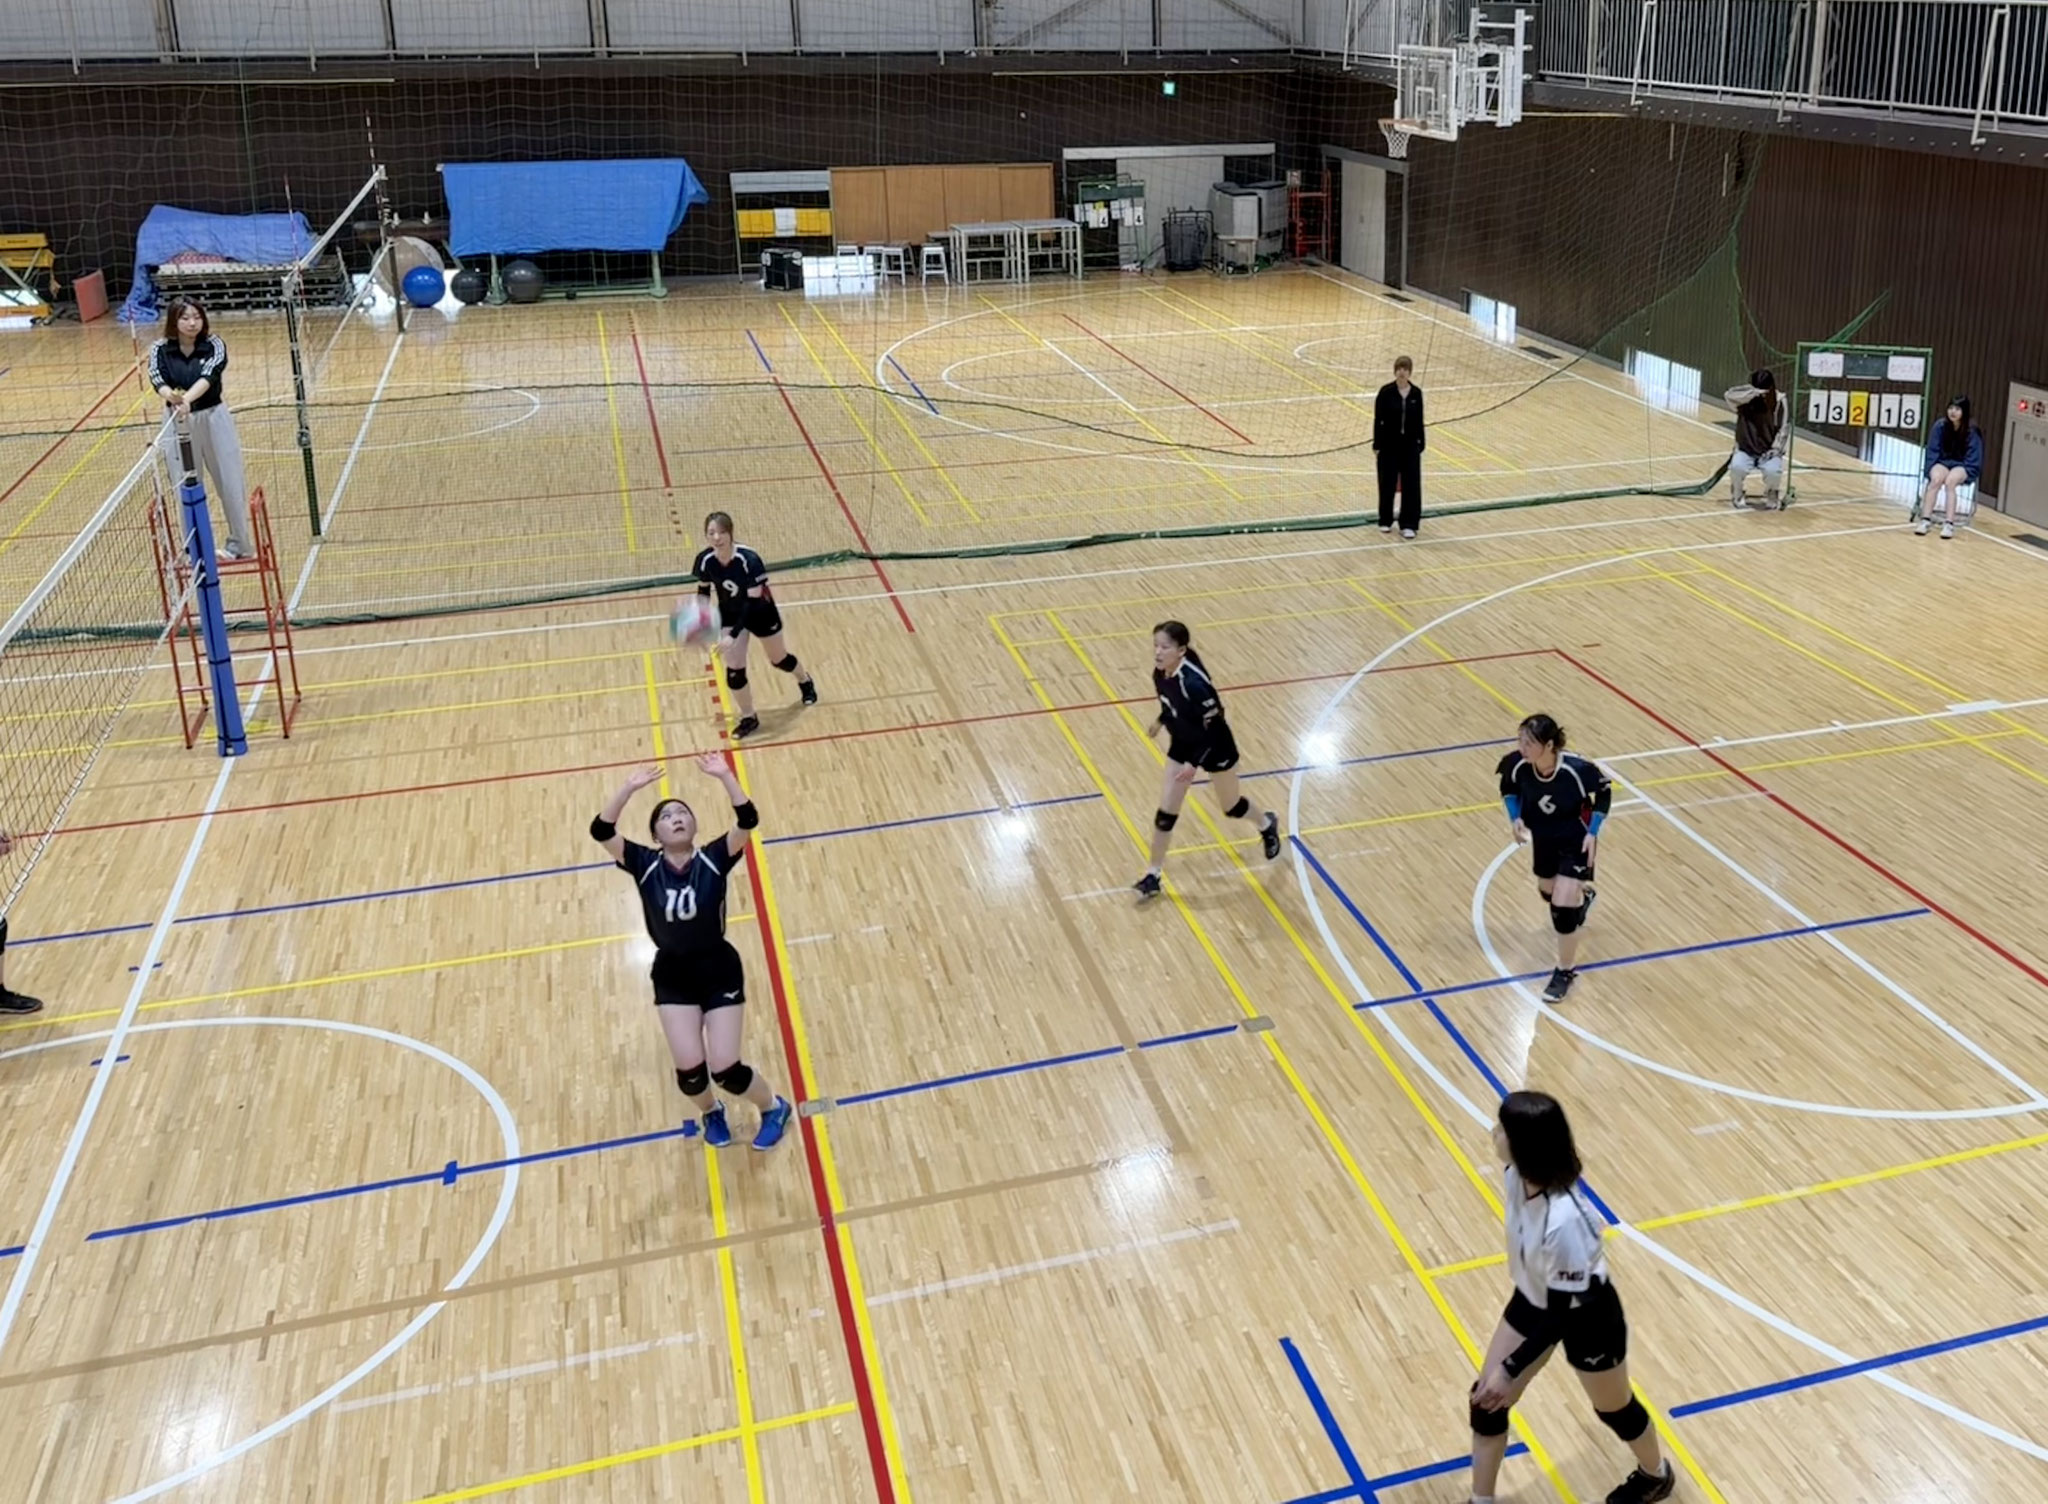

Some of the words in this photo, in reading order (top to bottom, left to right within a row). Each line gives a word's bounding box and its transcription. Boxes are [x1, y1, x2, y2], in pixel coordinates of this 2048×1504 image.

[1813, 403, 1843, 421] 13
[1852, 405, 1864, 422] 2
[1885, 408, 1916, 426] 18
[722, 579, 739, 597] 9
[1538, 794, 1557, 815] 6
[664, 885, 697, 922] 10
